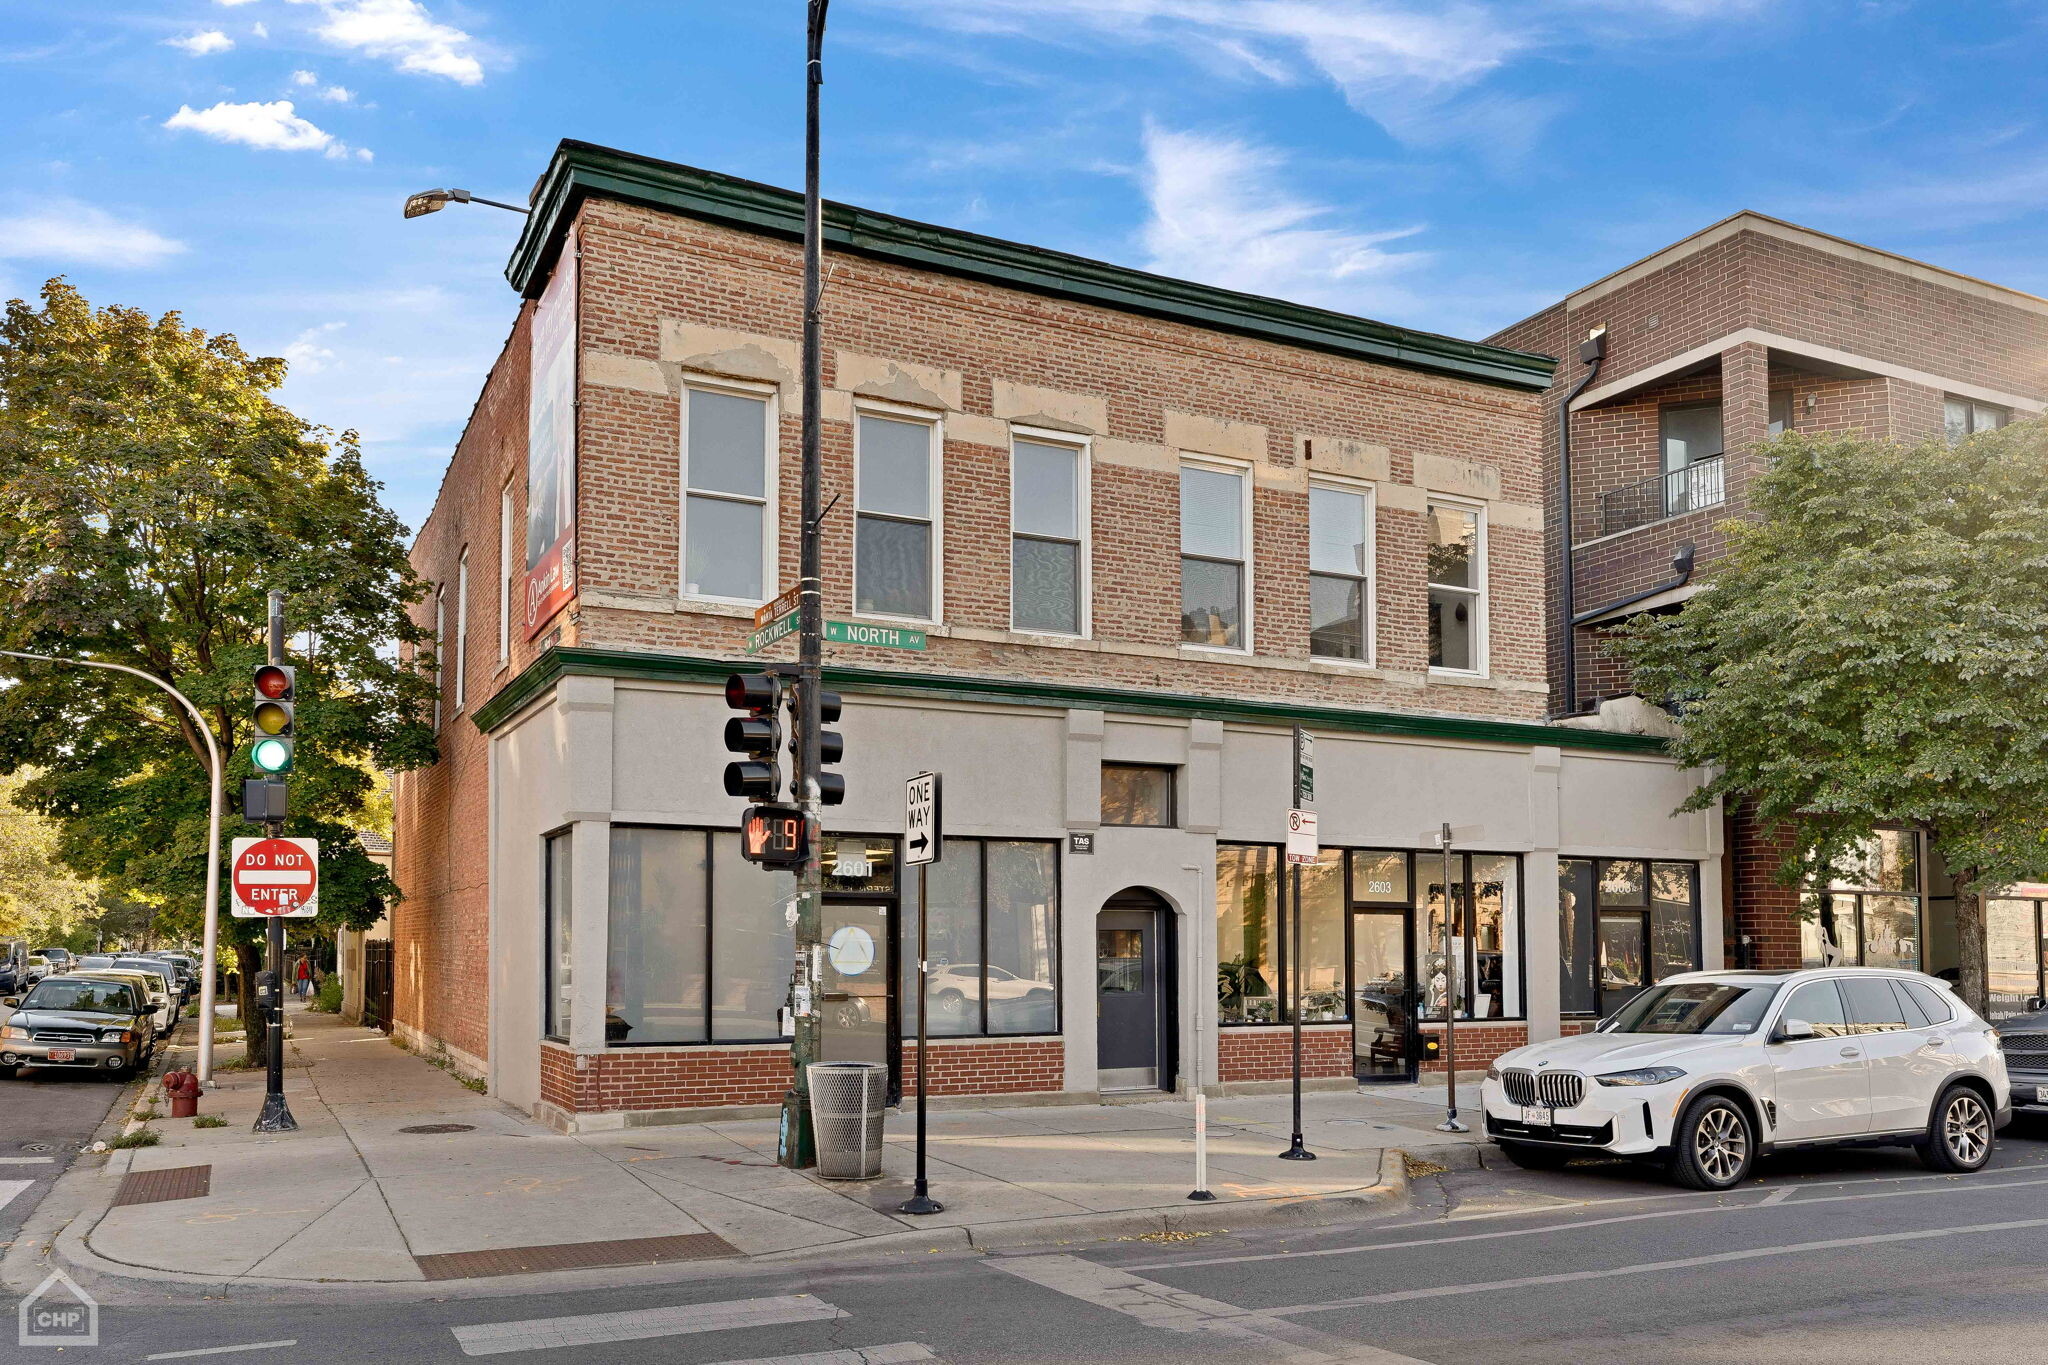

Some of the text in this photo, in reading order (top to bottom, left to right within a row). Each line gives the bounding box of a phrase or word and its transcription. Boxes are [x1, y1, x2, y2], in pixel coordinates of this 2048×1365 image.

[793, 594, 799, 606] ST
[755, 618, 792, 649] ROCKWELL
[830, 625, 920, 645] W NORTH AV
[909, 781, 930, 805] ONE
[908, 805, 930, 829] WAY
[1073, 837, 1090, 845] TAS
[246, 854, 304, 866] DO NOT
[1289, 854, 1316, 864] TOW ZONE
[831, 860, 873, 877] 2601
[1368, 881, 1392, 894] 2603
[1989, 993, 2019, 1003] Weight
